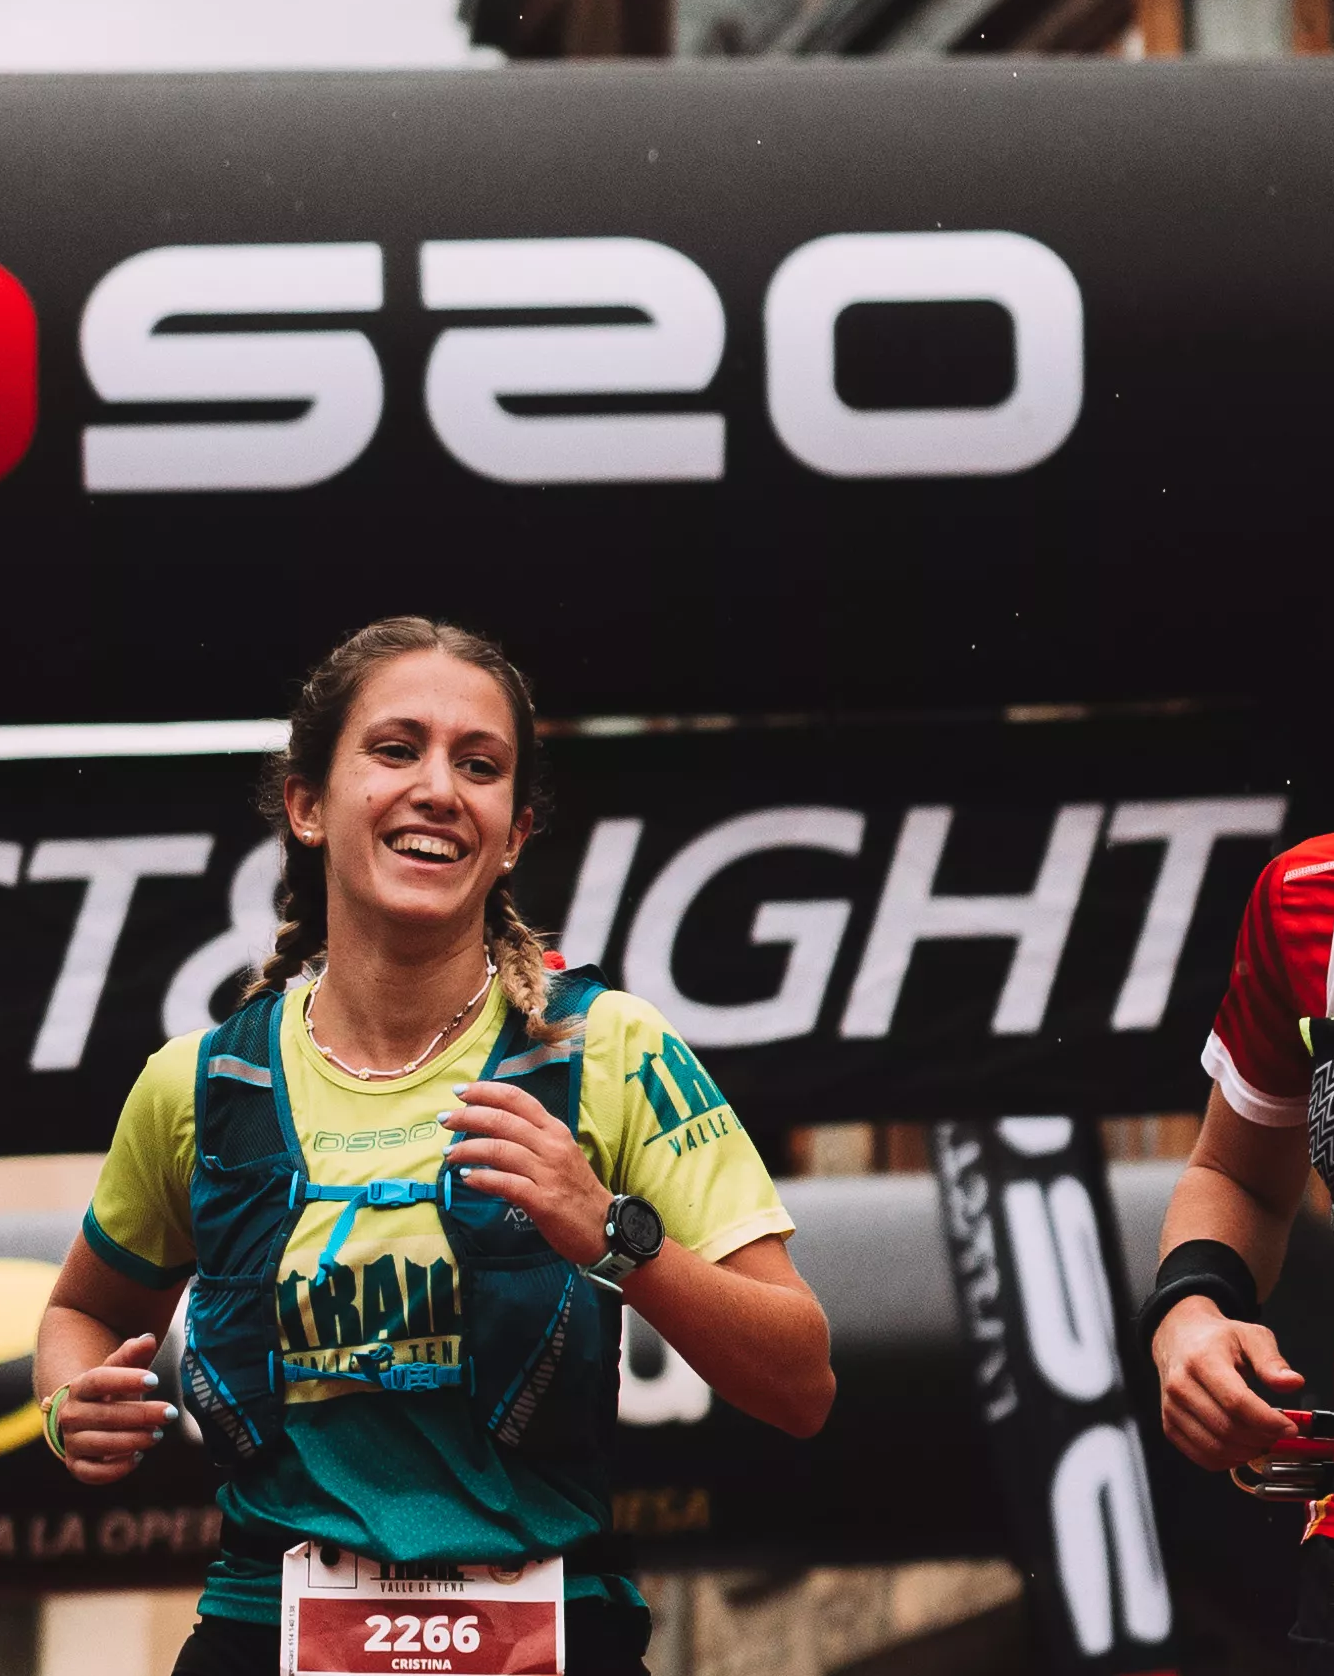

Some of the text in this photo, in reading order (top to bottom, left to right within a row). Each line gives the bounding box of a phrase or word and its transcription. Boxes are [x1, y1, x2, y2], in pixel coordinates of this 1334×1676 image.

[668, 1113, 729, 1157] VALLE
[409, 1340, 453, 1365] TEN
[380, 1582, 466, 1593] VALLE DE TENA
[364, 1615, 481, 1652] 2266
[391, 1658, 452, 1670] CRISTINA
